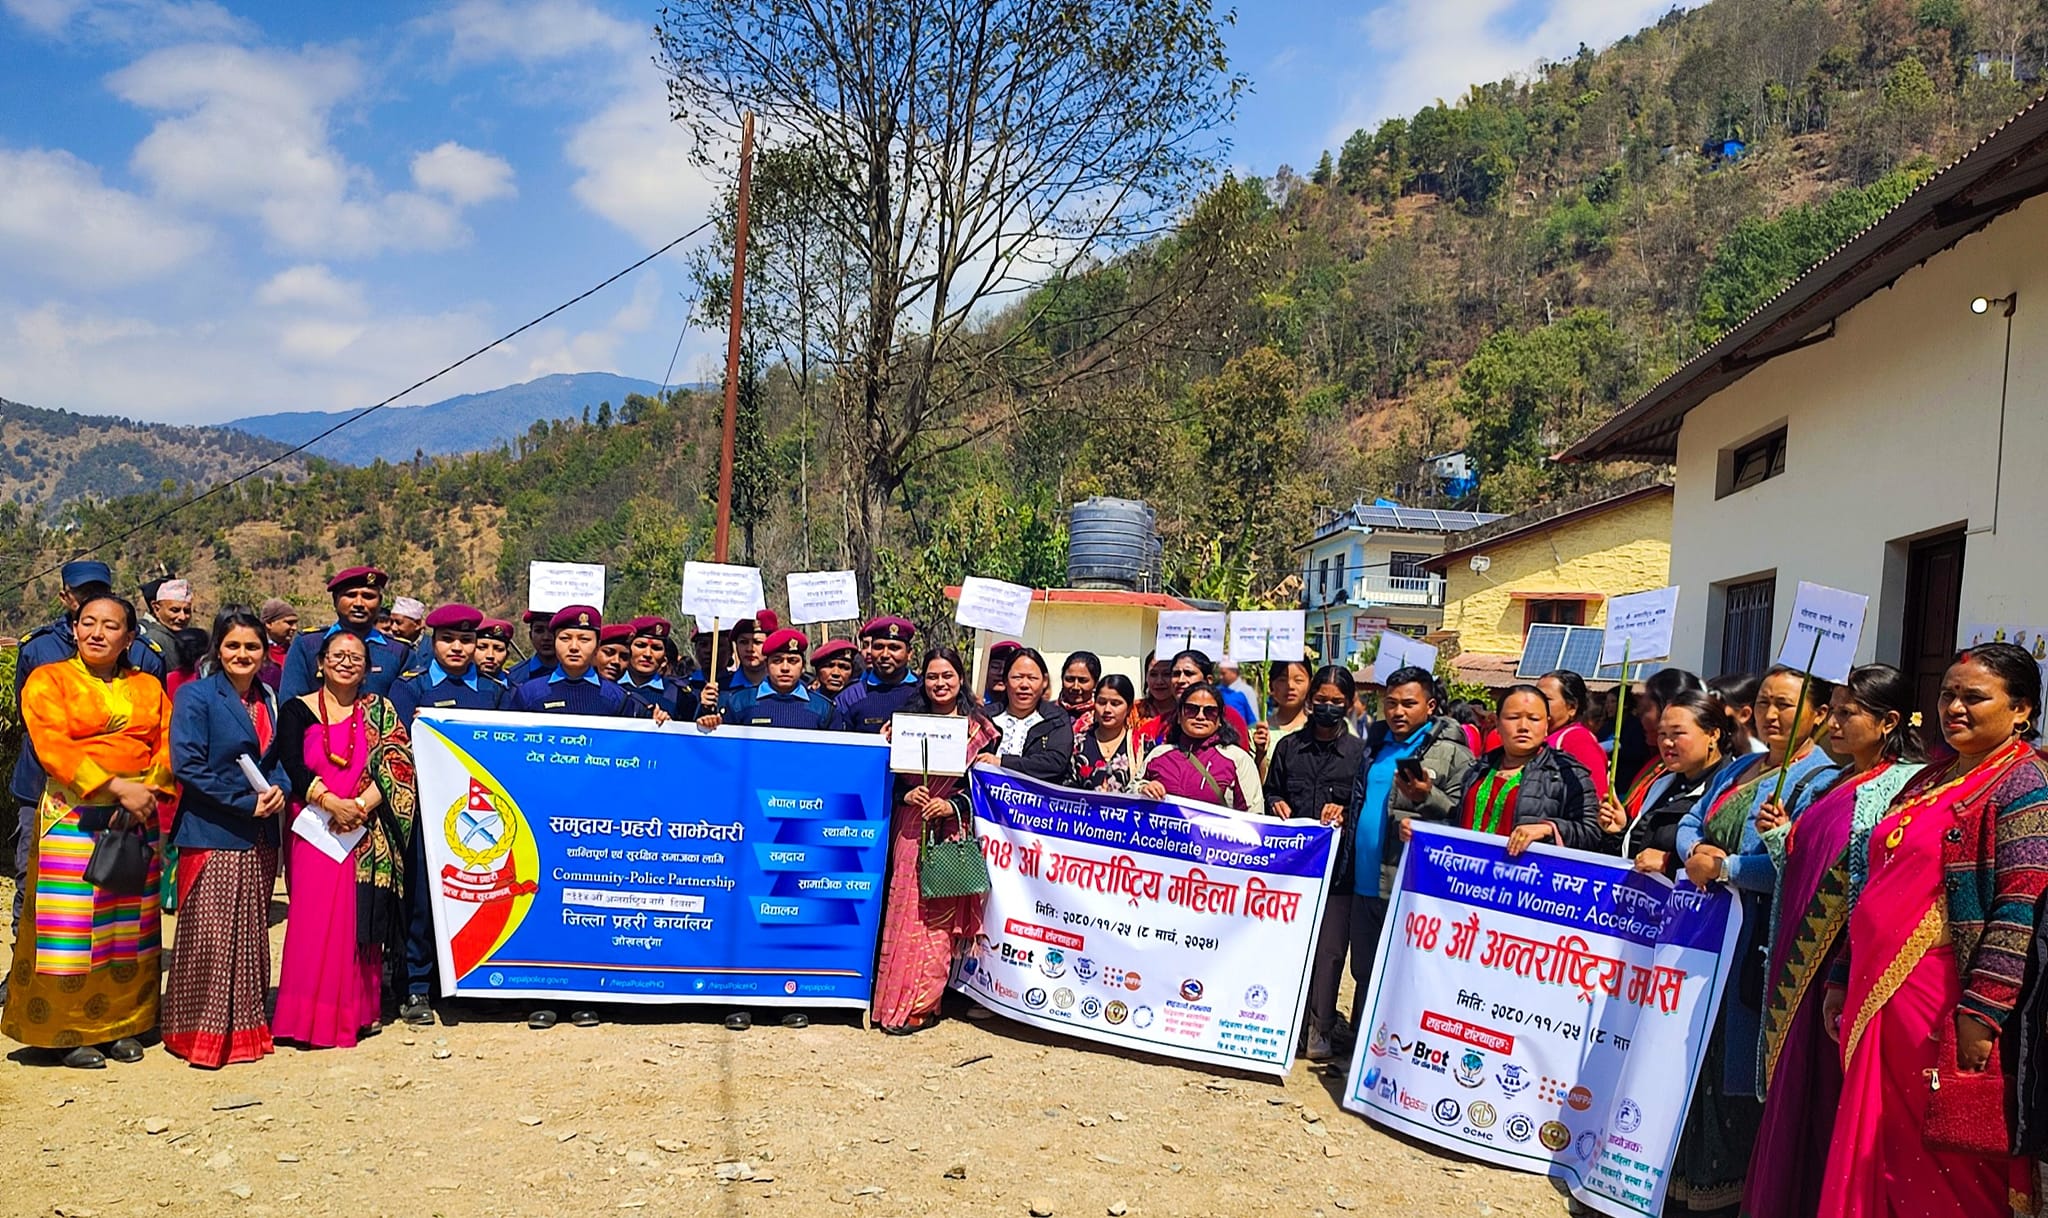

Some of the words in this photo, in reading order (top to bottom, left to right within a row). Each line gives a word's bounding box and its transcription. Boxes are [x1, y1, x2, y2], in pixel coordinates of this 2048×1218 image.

[767, 795, 796, 809] नेपाल
[799, 798, 823, 810] प्रहरी
[1100, 805, 1129, 823] सभ्य
[1133, 810, 1144, 828] र
[1148, 812, 1193, 836] समुन्नत
[822, 826, 858, 838] स्थानीय
[860, 828, 875, 839] तह
[1008, 808, 1053, 831] "Invest
[1056, 817, 1069, 833] in
[1073, 820, 1127, 843] Women:
[1129, 833, 1202, 857] Accelerate
[1206, 847, 1276, 866] progress"
[769, 851, 805, 864] समुदाय
[553, 867, 665, 886] Community-Police
[667, 871, 736, 891] Partnership
[798, 877, 841, 890] सामाजिक
[845, 880, 871, 891] संस्था
[1552, 872, 1588, 895] सभ्य
[1593, 880, 1607, 902] र
[1168, 867, 1239, 916] महिला
[1243, 876, 1302, 924] दिवस
[1447, 875, 1496, 902] "Invest
[1498, 887, 1513, 905] in
[1518, 891, 1582, 920] Women:
[562, 908, 606, 928] जिल्ला
[612, 912, 647, 931] प्रहरी
[653, 913, 713, 931] कार्यालय
[760, 903, 799, 916] विद्यालय
[1001, 942, 1034, 964] Brot
[1185, 935, 1219, 951] २०२४)
[1414, 1041, 1450, 1066] Brot
[1463, 1127, 1494, 1141] OCMC
